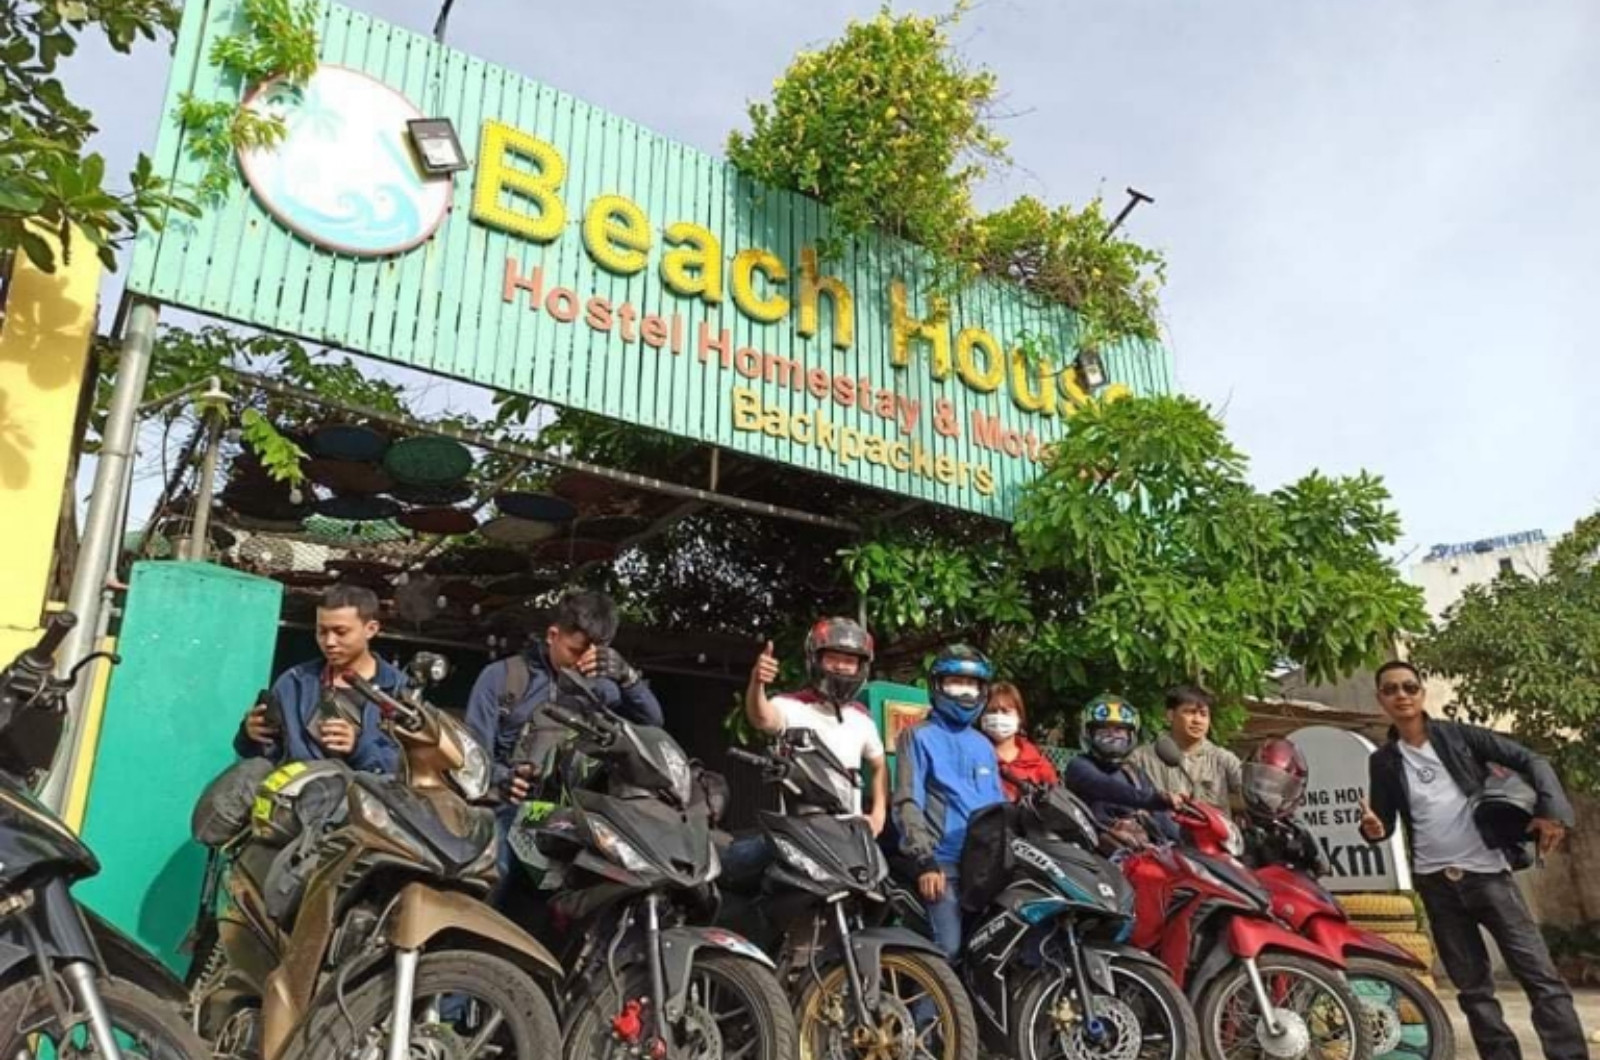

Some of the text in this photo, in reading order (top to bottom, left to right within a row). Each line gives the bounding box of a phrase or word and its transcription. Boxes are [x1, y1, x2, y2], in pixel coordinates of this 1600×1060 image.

[470, 117, 853, 348] Beach
[502, 257, 1060, 470] Hostel Homestay & Mote
[732, 384, 996, 496] Backpackers
[1303, 810, 1328, 826] ME
[1320, 837, 1387, 878] km
